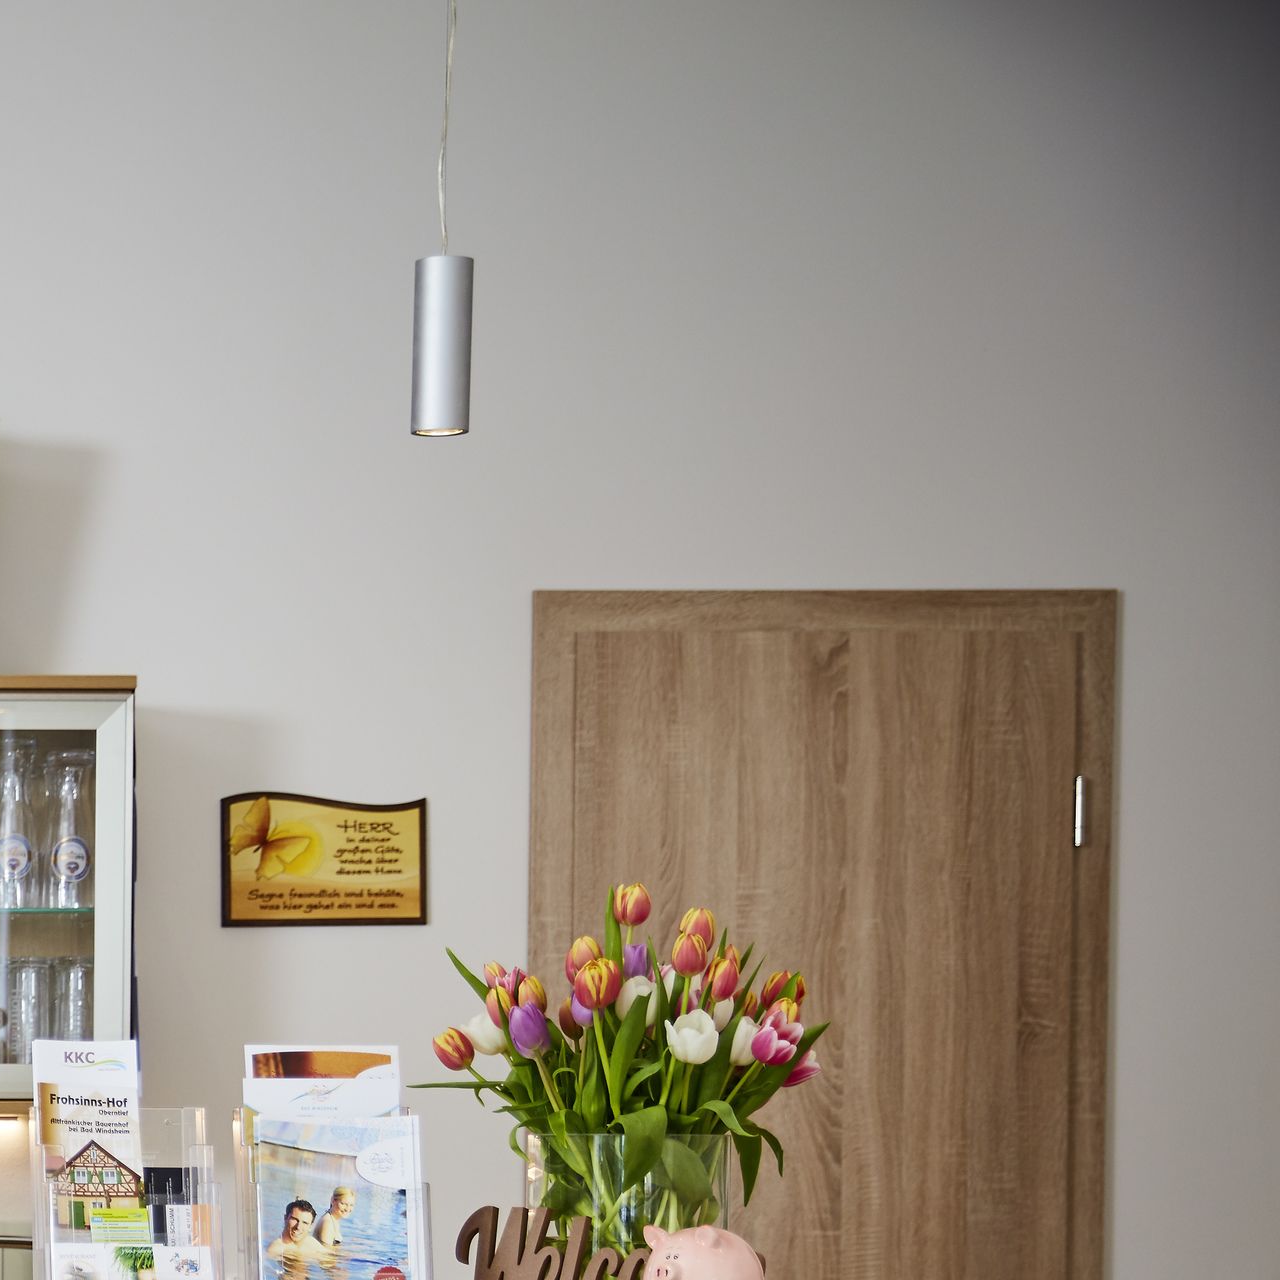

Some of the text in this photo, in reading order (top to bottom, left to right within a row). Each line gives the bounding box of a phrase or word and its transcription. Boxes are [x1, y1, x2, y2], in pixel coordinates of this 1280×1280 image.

[336, 819, 400, 836] HERR
[344, 888, 363, 898] und
[355, 900, 374, 909] und
[64, 1051, 96, 1064] KKC
[49, 1093, 128, 1108] Frohsinns-Hof
[95, 1120, 129, 1128] Bauernhof
